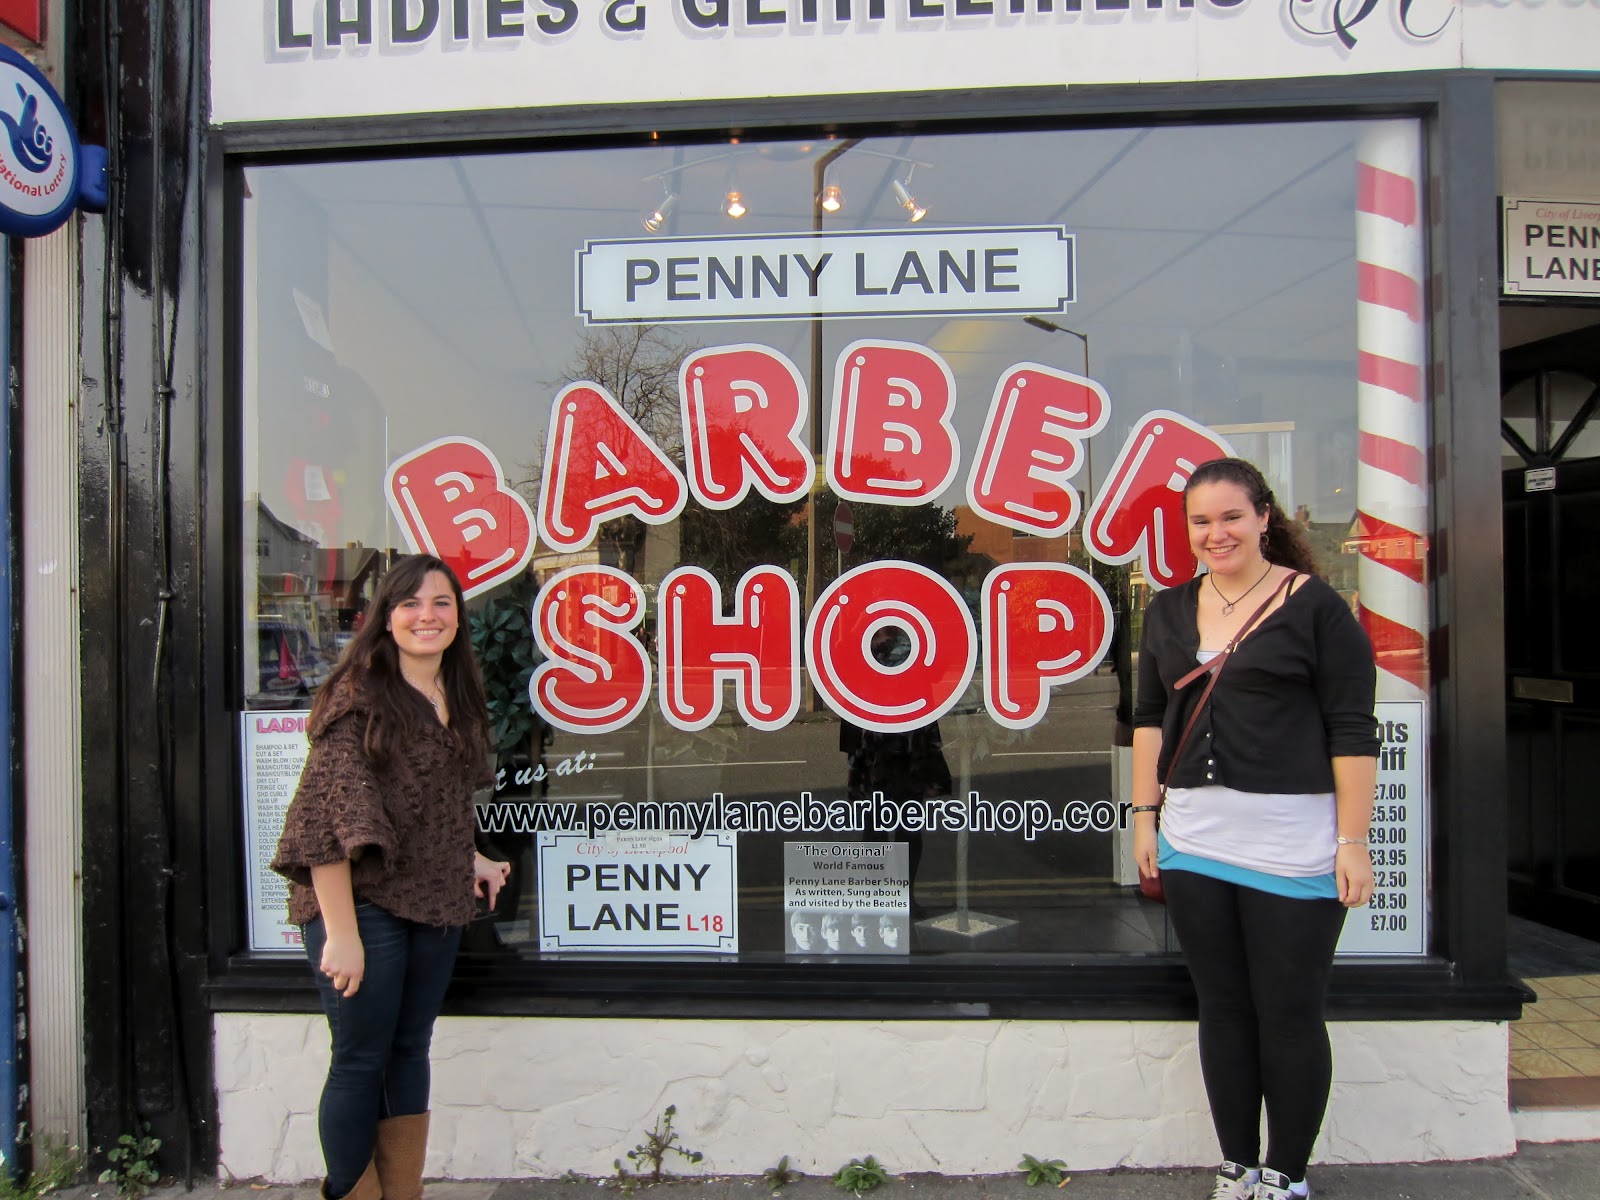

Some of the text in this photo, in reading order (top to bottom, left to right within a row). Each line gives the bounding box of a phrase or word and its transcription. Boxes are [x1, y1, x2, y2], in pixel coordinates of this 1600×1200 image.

[277, 0, 579, 48] LADIES
[0, 153, 67, 197] ational Lottery
[626, 247, 1020, 302] PENNY LANE
[384, 338, 1238, 598] BARBER
[529, 561, 1114, 733] SHOP
[515, 766, 548, 786] us
[556, 750, 596, 777] at:
[1371, 805, 1407, 822] £5.50
[1368, 827, 1407, 844] £9.00
[577, 842, 604, 858] City
[1368, 849, 1407, 866] £3.95
[813, 861, 885, 870] World Famous
[567, 864, 711, 891] PENNY
[789, 877, 909, 888] Penny Lane Barber Shop
[795, 888, 901, 898] As written, Sung about
[1368, 893, 1407, 909] £8.50
[789, 899, 908, 909] and visited by the Beatles
[568, 903, 724, 932] LANE L18
[1371, 914, 1407, 931] £7.00
